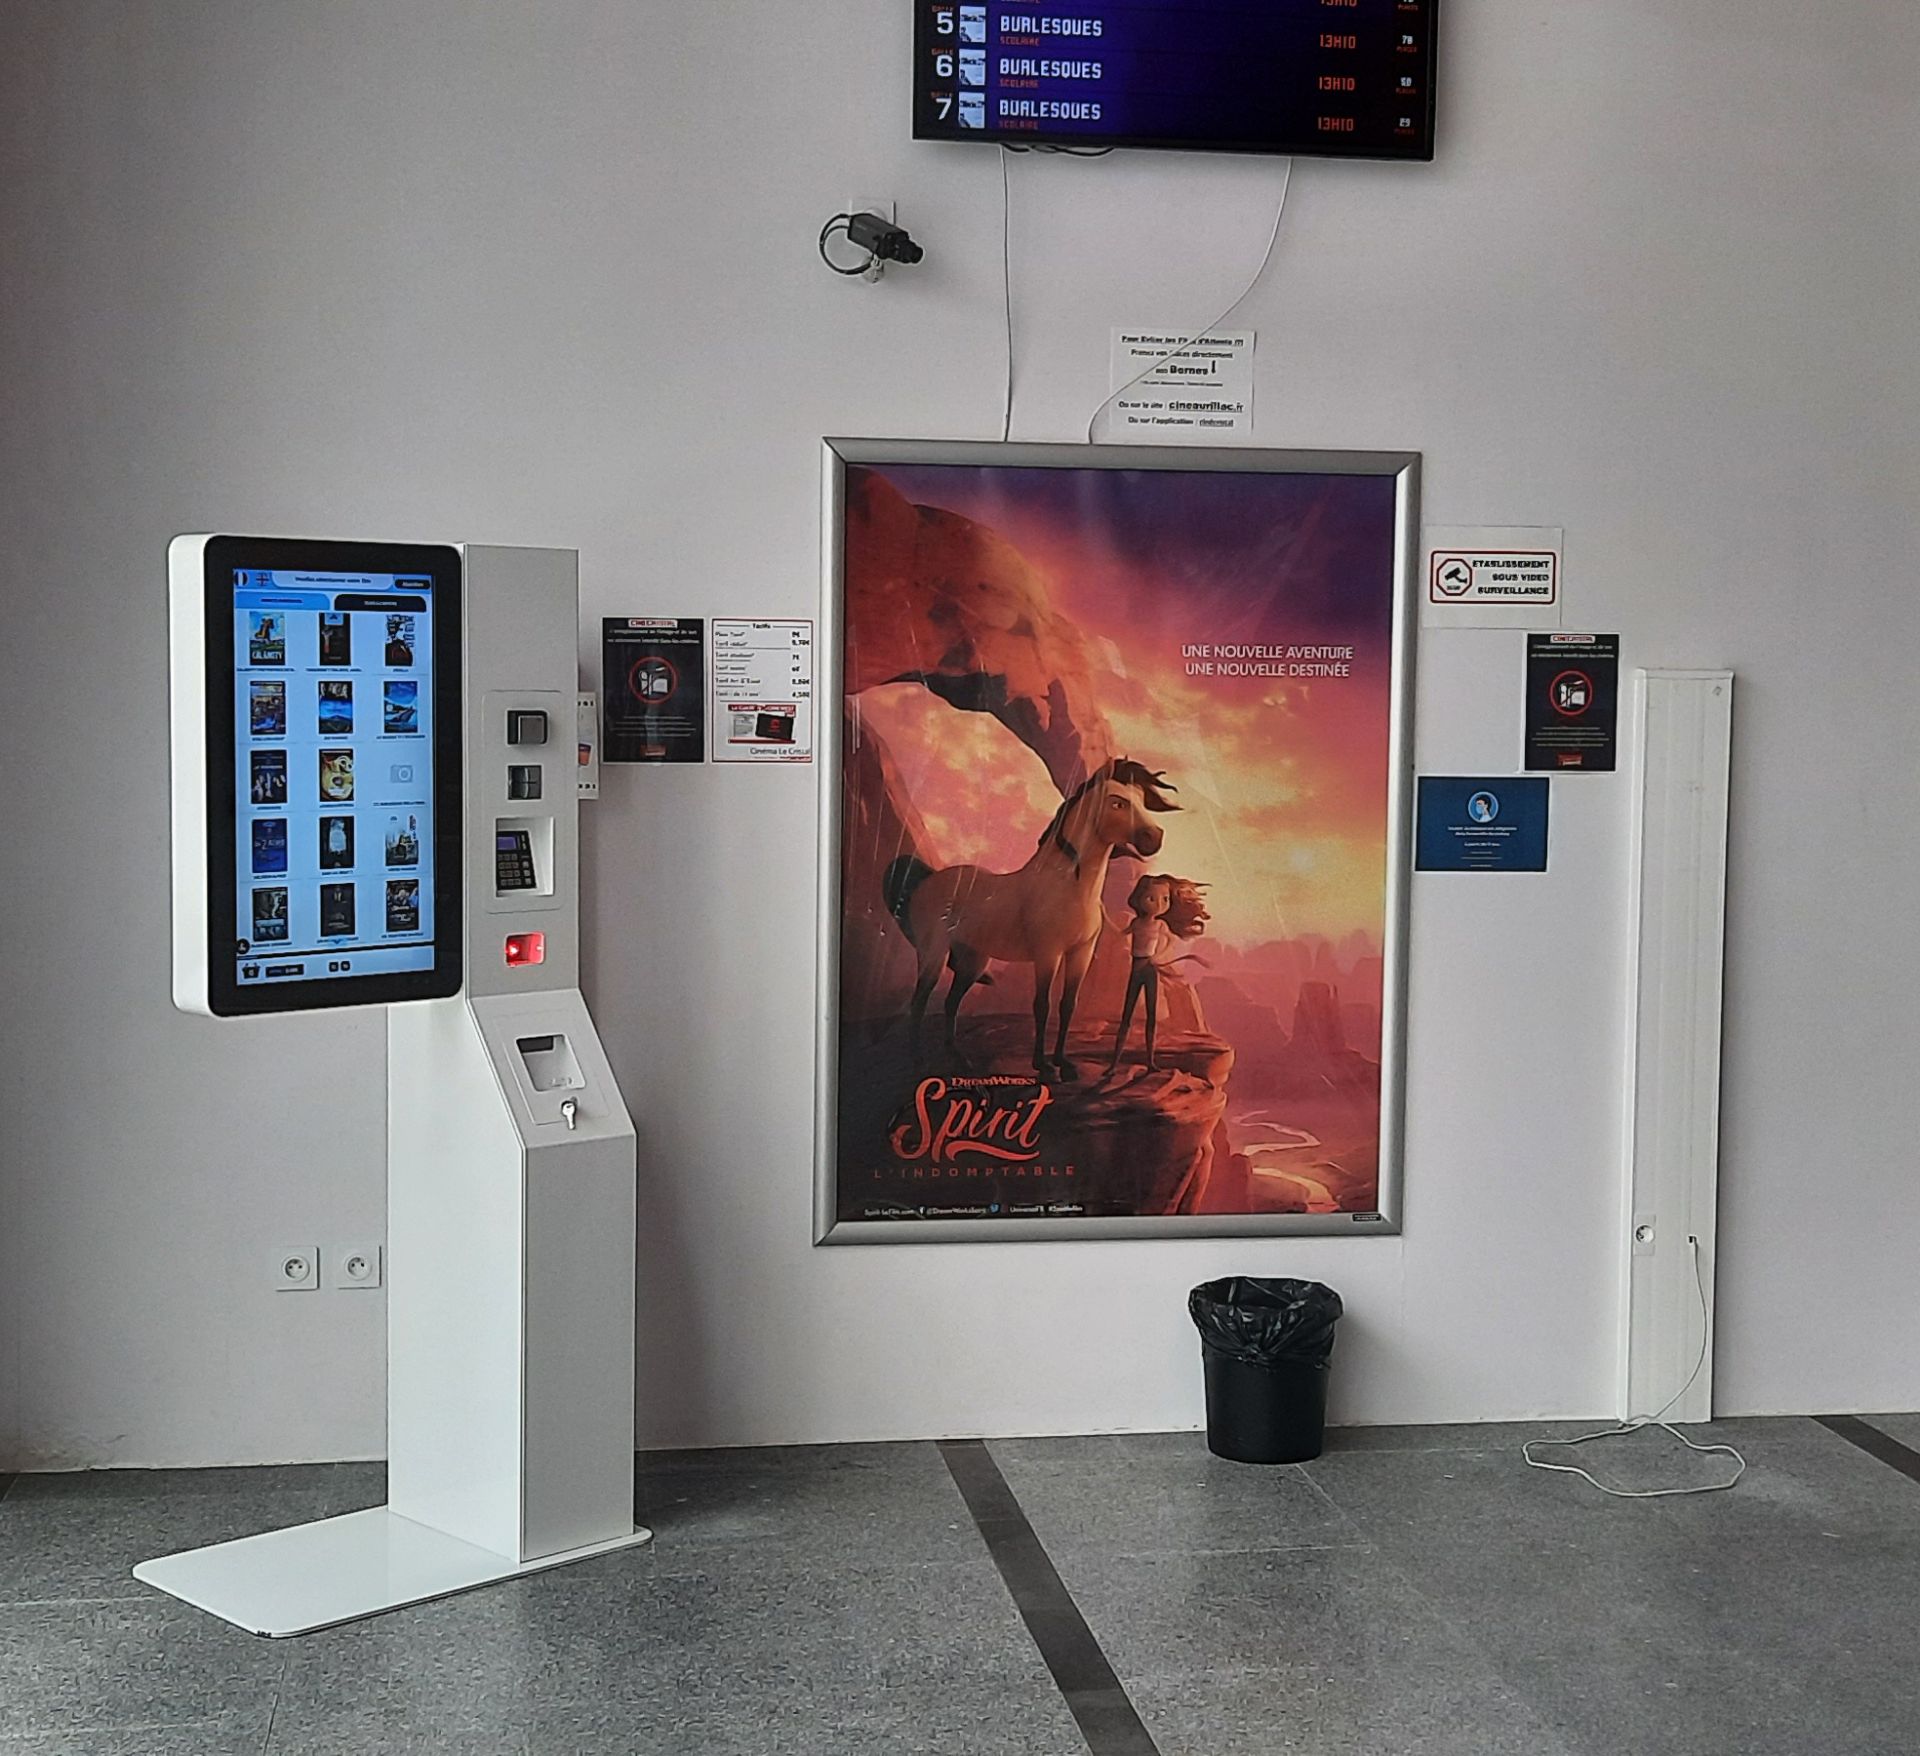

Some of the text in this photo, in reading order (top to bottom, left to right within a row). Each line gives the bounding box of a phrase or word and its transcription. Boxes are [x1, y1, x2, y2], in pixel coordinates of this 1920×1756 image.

[936, 12, 954, 35] 5
[1000, 15, 1103, 37] BURLESQUES
[1320, 34, 1356, 49] 13H10
[935, 54, 953, 77] 6
[1000, 58, 1102, 79] BURLESQUES
[1319, 77, 1355, 91] 13H10
[935, 97, 952, 120] 7
[999, 99, 1101, 120] BURLESQUES
[1318, 117, 1354, 131] 13H10
[1169, 364, 1208, 375] Bornes
[1169, 401, 1244, 411] cineaurillac.fr
[1472, 559, 1550, 569] ETABLISSEMENT
[1492, 573, 1550, 582] SOUS VIDEO
[1477, 586, 1549, 595] SURVEILLANCE
[1182, 645, 1353, 660] UNE NOUVELLE AVENTURE
[1185, 661, 1350, 677] UNE NOUVELLE DESTINÉE
[890, 1077, 1054, 1163] Spirit
[873, 1165, 1076, 1179] L'INDOMPTABLE
